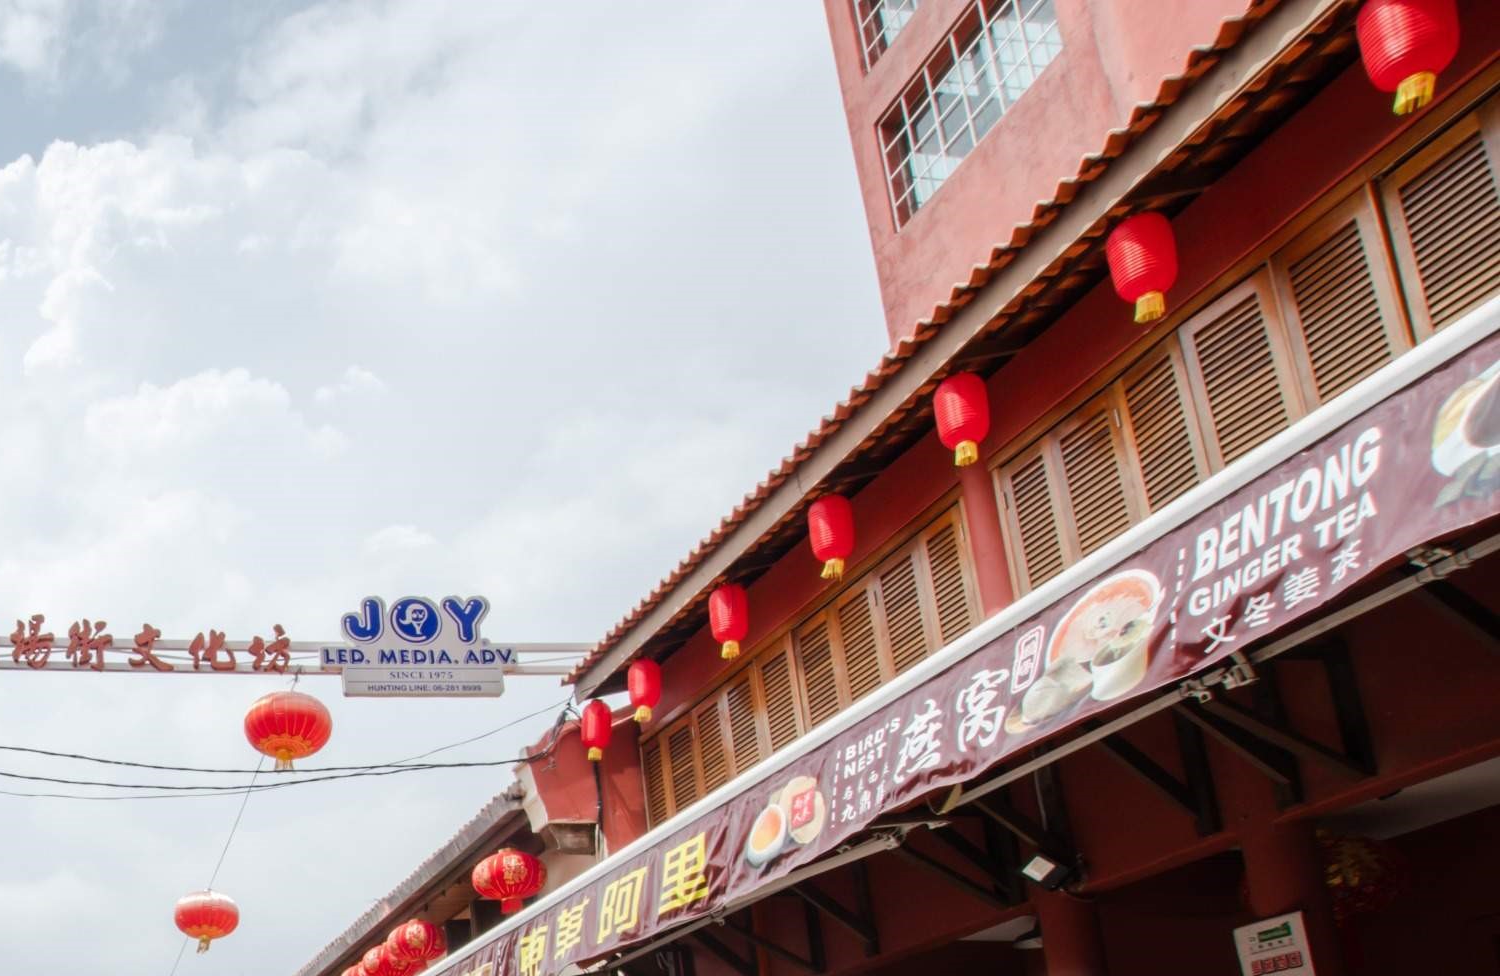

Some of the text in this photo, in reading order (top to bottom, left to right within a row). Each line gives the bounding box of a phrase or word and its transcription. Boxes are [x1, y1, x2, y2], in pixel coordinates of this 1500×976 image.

[1192, 426, 1382, 582] BENTONG
[1187, 492, 1378, 617] GINGER TEA
[343, 598, 488, 644] JOY
[367, 684, 407, 692] HUNTING
[389, 671, 454, 680] SINCE 1975
[843, 741, 888, 780] NEST
[845, 717, 901, 762] BIRD'S
